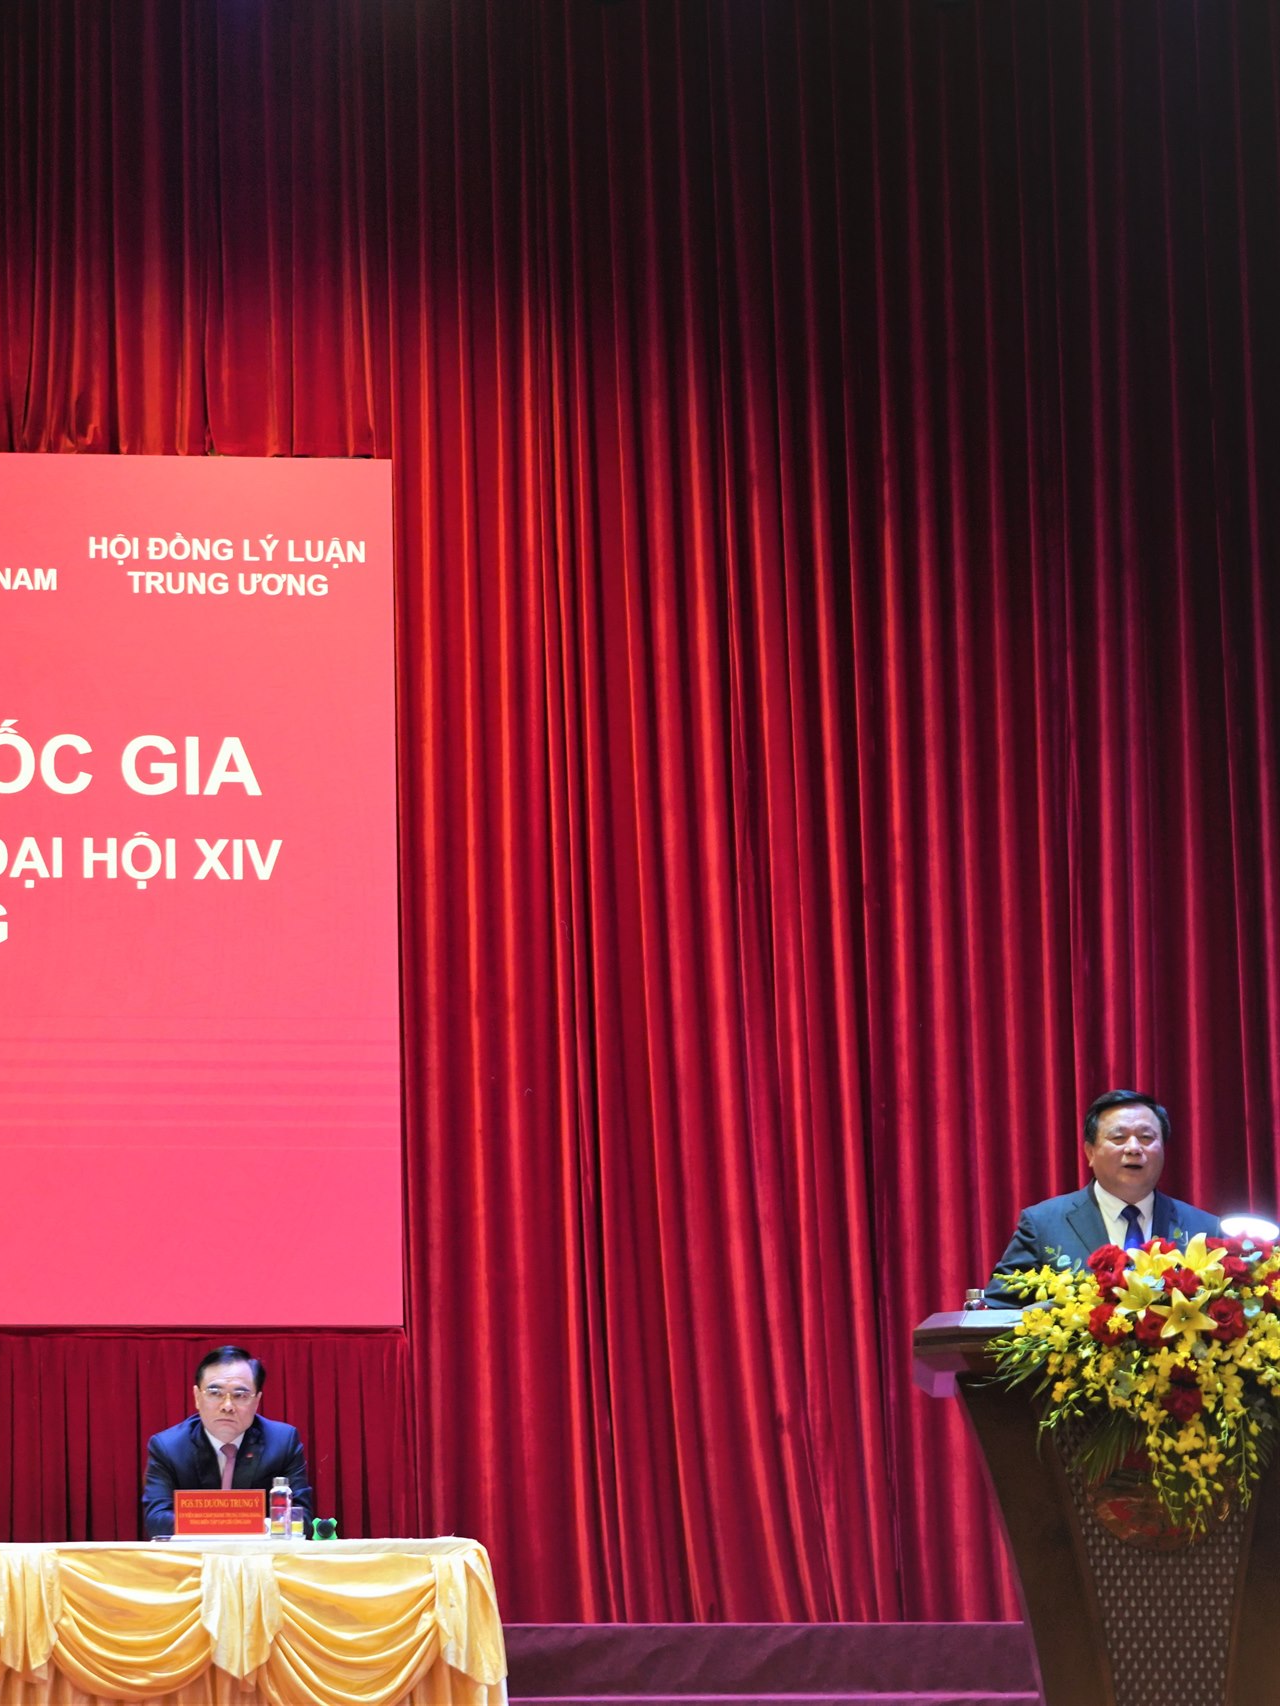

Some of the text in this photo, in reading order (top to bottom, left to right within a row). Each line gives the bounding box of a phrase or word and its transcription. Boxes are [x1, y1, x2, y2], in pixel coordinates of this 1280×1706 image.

[88, 532, 366, 570] HỘI ĐỒNG LÝ LUẬN
[126, 570, 329, 597] TRUNG ƯƠNG
[120, 734, 263, 797] GIA
[82, 831, 177, 890] HỘI
[193, 838, 283, 881] XIV
[230, 1499, 253, 1508] TRUNG
